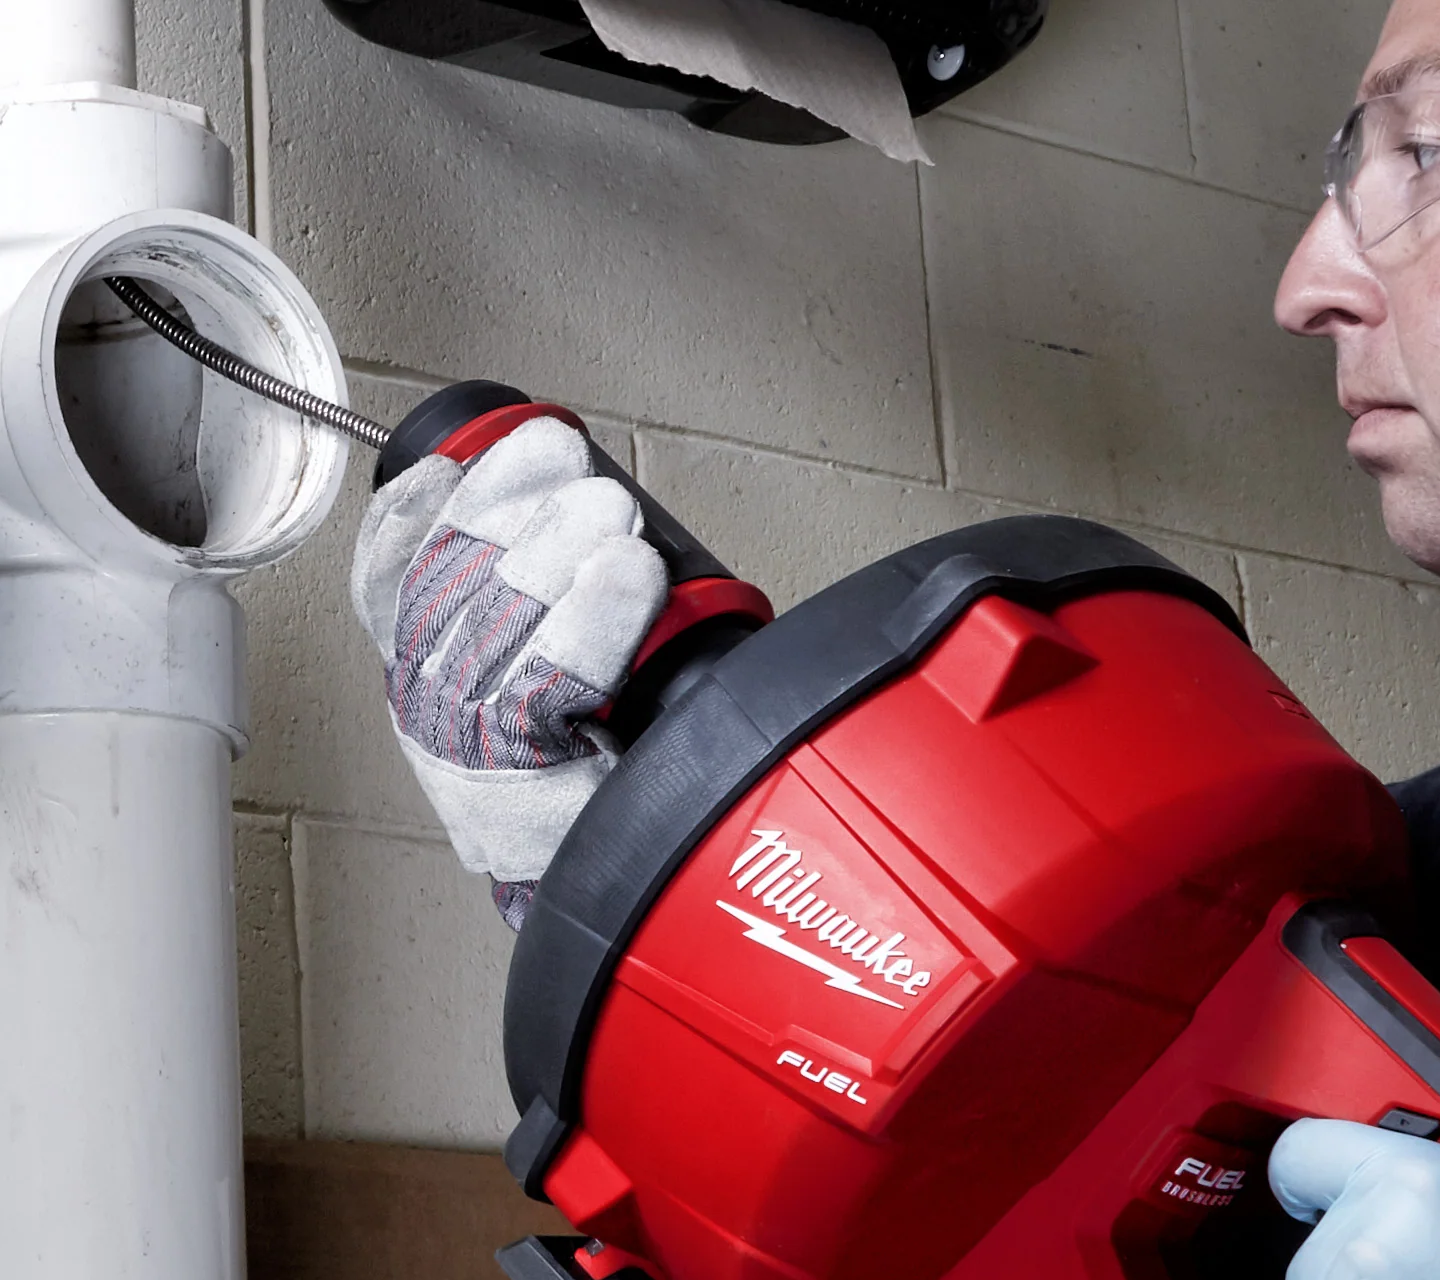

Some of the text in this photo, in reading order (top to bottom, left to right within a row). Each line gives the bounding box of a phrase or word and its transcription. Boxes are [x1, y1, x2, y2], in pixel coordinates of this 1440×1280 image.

[729, 830, 931, 996] Milwaukee
[776, 1050, 868, 1105] FUEL
[1174, 1157, 1246, 1190] FUEL
